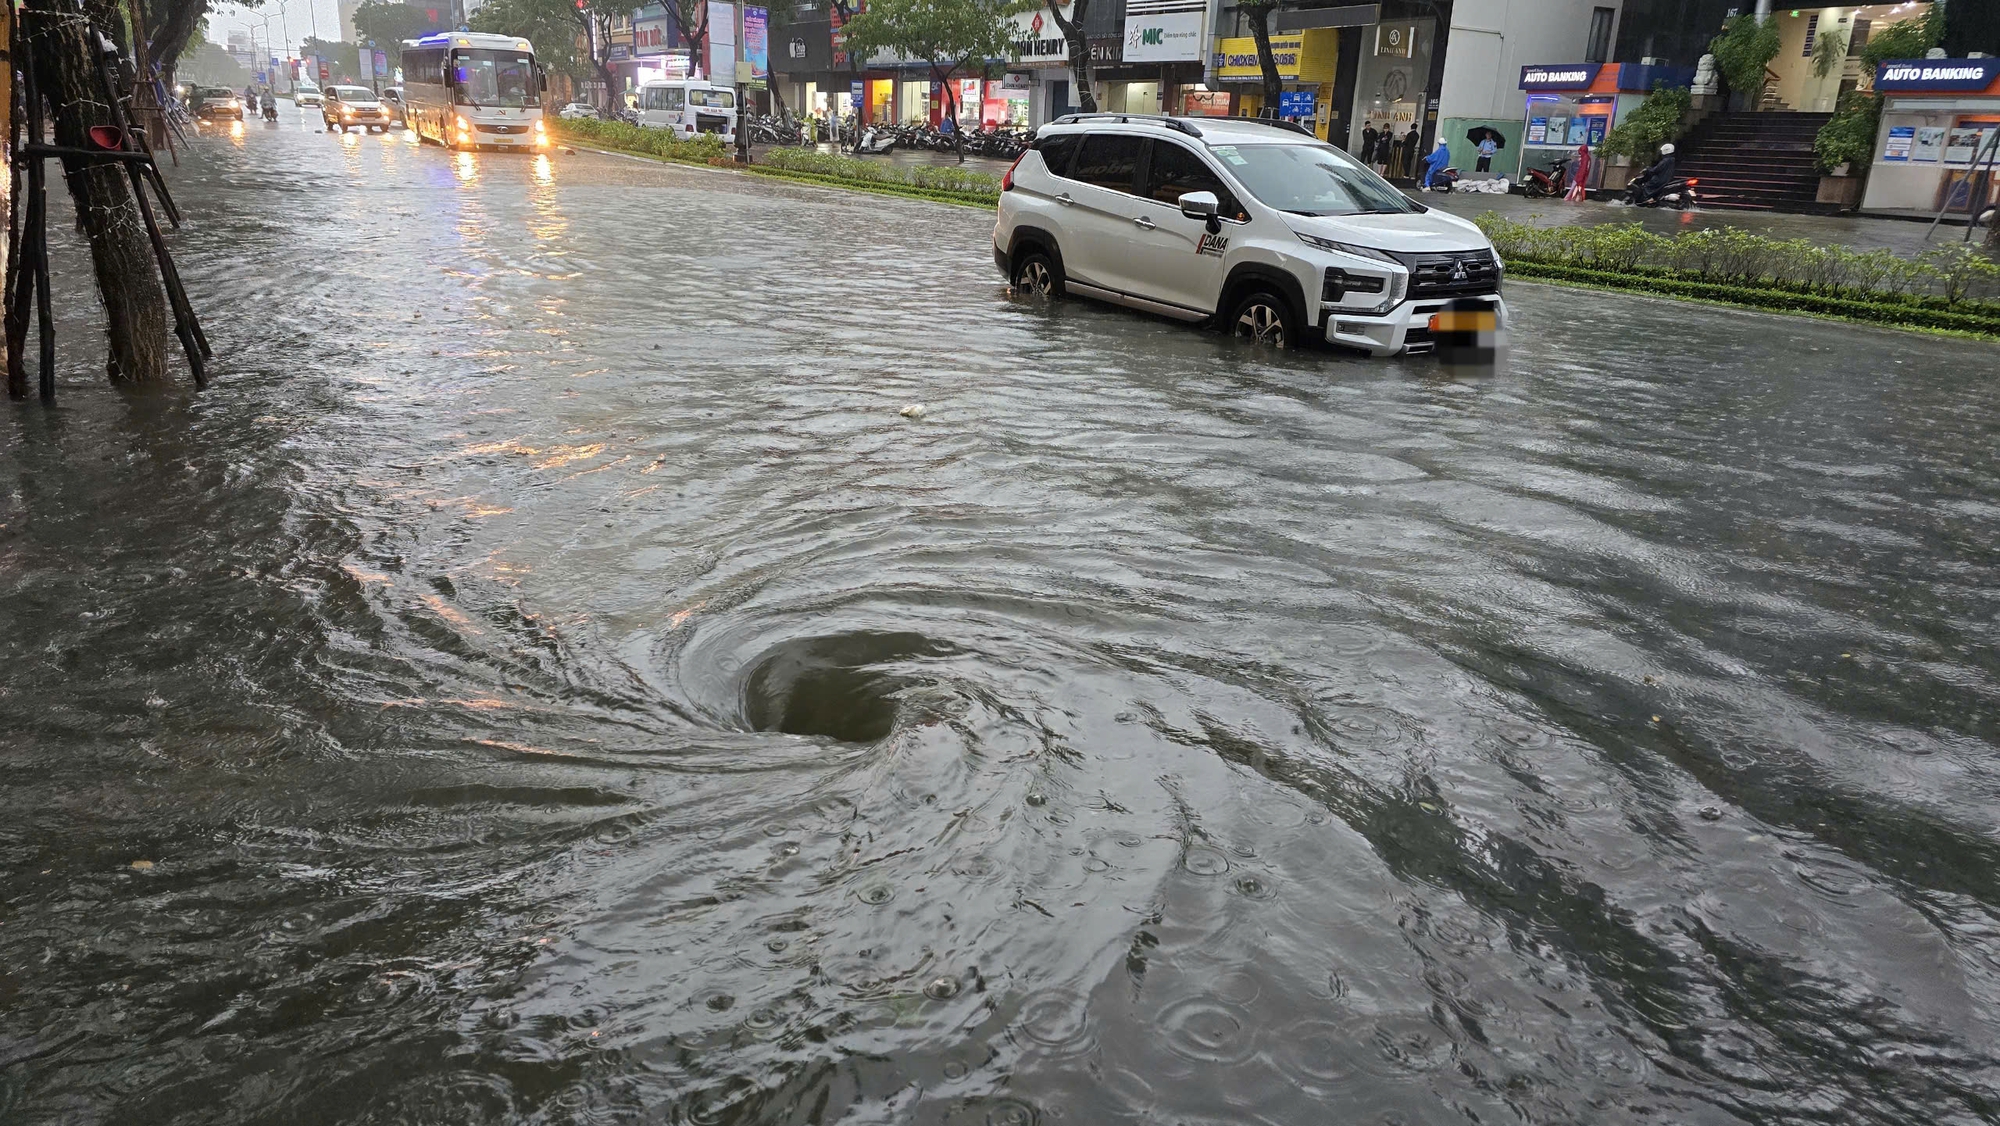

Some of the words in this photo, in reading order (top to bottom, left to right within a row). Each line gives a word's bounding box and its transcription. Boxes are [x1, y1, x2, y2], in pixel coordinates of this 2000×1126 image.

[1726, 7, 1739, 18] 167
[1142, 28, 1163, 45] MIC
[1034, 38, 1065, 56] HENRY
[1524, 73, 1547, 82] AUTO
[1548, 71, 1587, 82] BANKING
[1883, 69, 1921, 80] AUTO
[1921, 67, 1984, 80] BANKING
[1394, 112, 1413, 122] ANH
[1204, 235, 1228, 250] DANA
